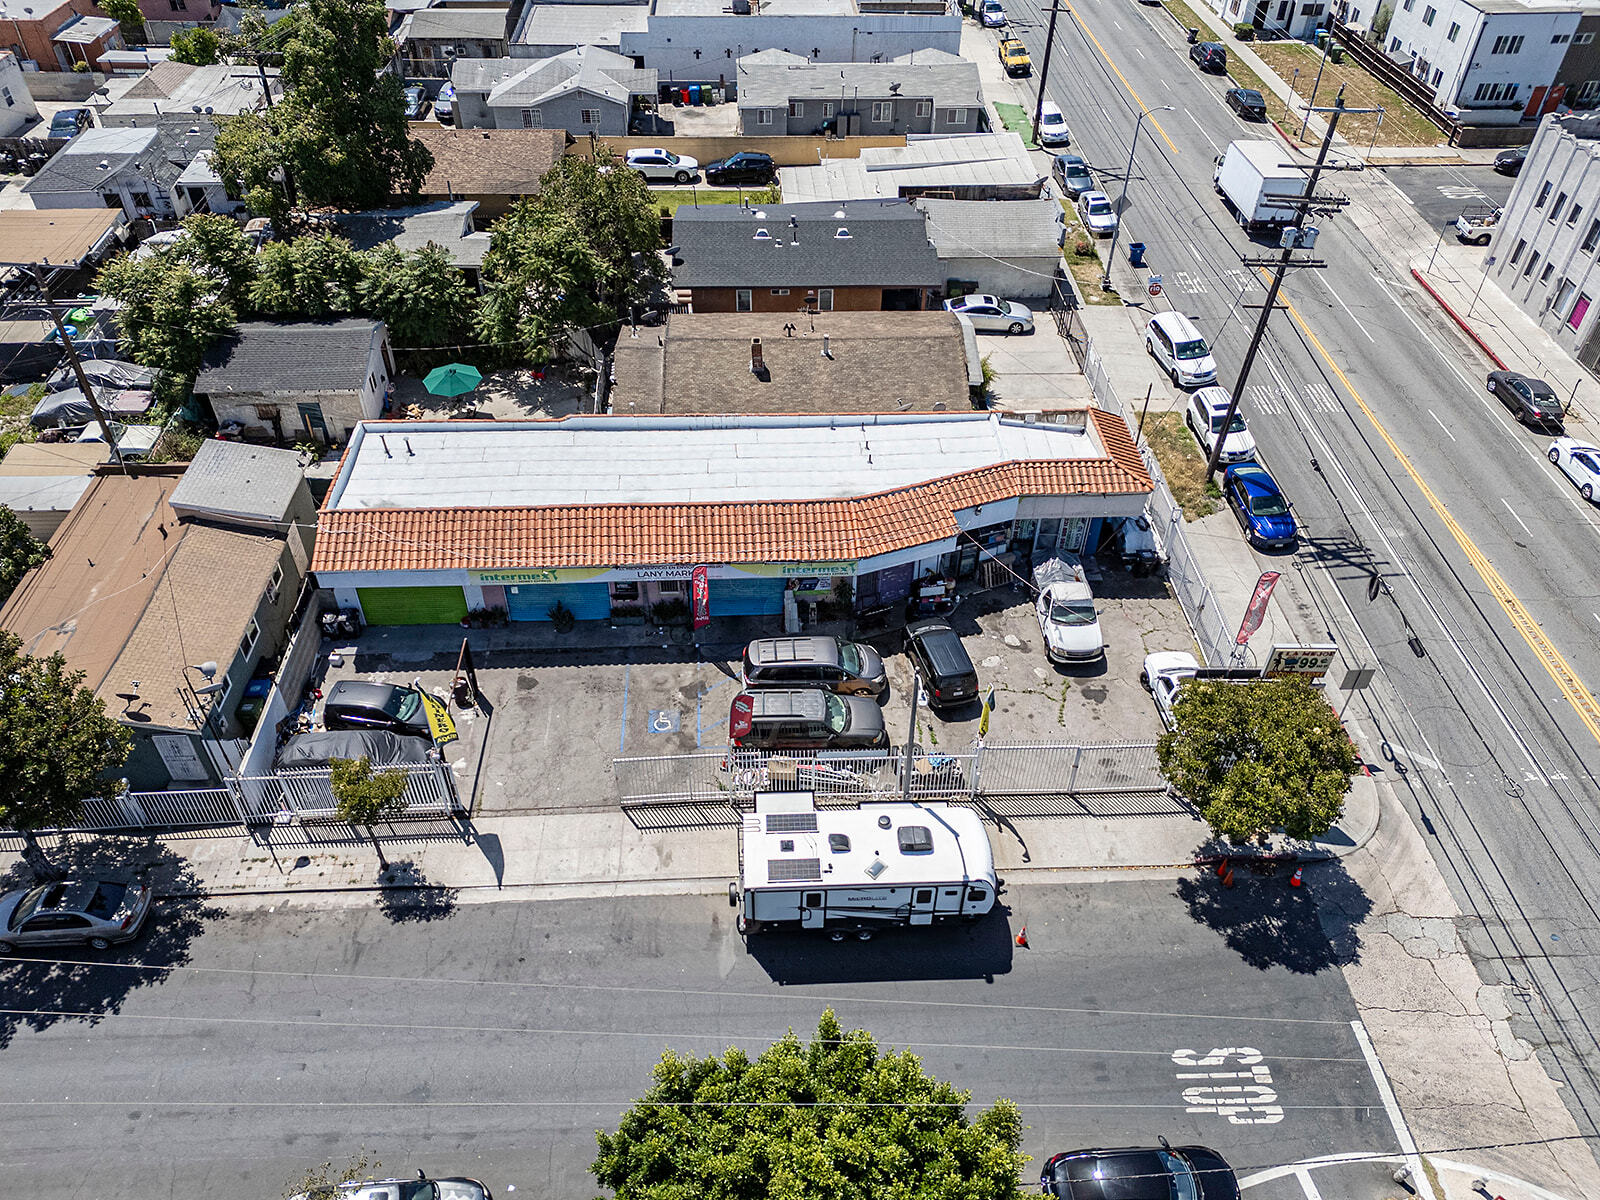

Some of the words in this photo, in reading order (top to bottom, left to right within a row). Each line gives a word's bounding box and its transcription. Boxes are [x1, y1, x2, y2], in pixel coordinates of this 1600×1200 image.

[783, 566, 848, 574] intermex
[480, 573, 551, 581] intermex
[1171, 1046, 1285, 1125] STOP
